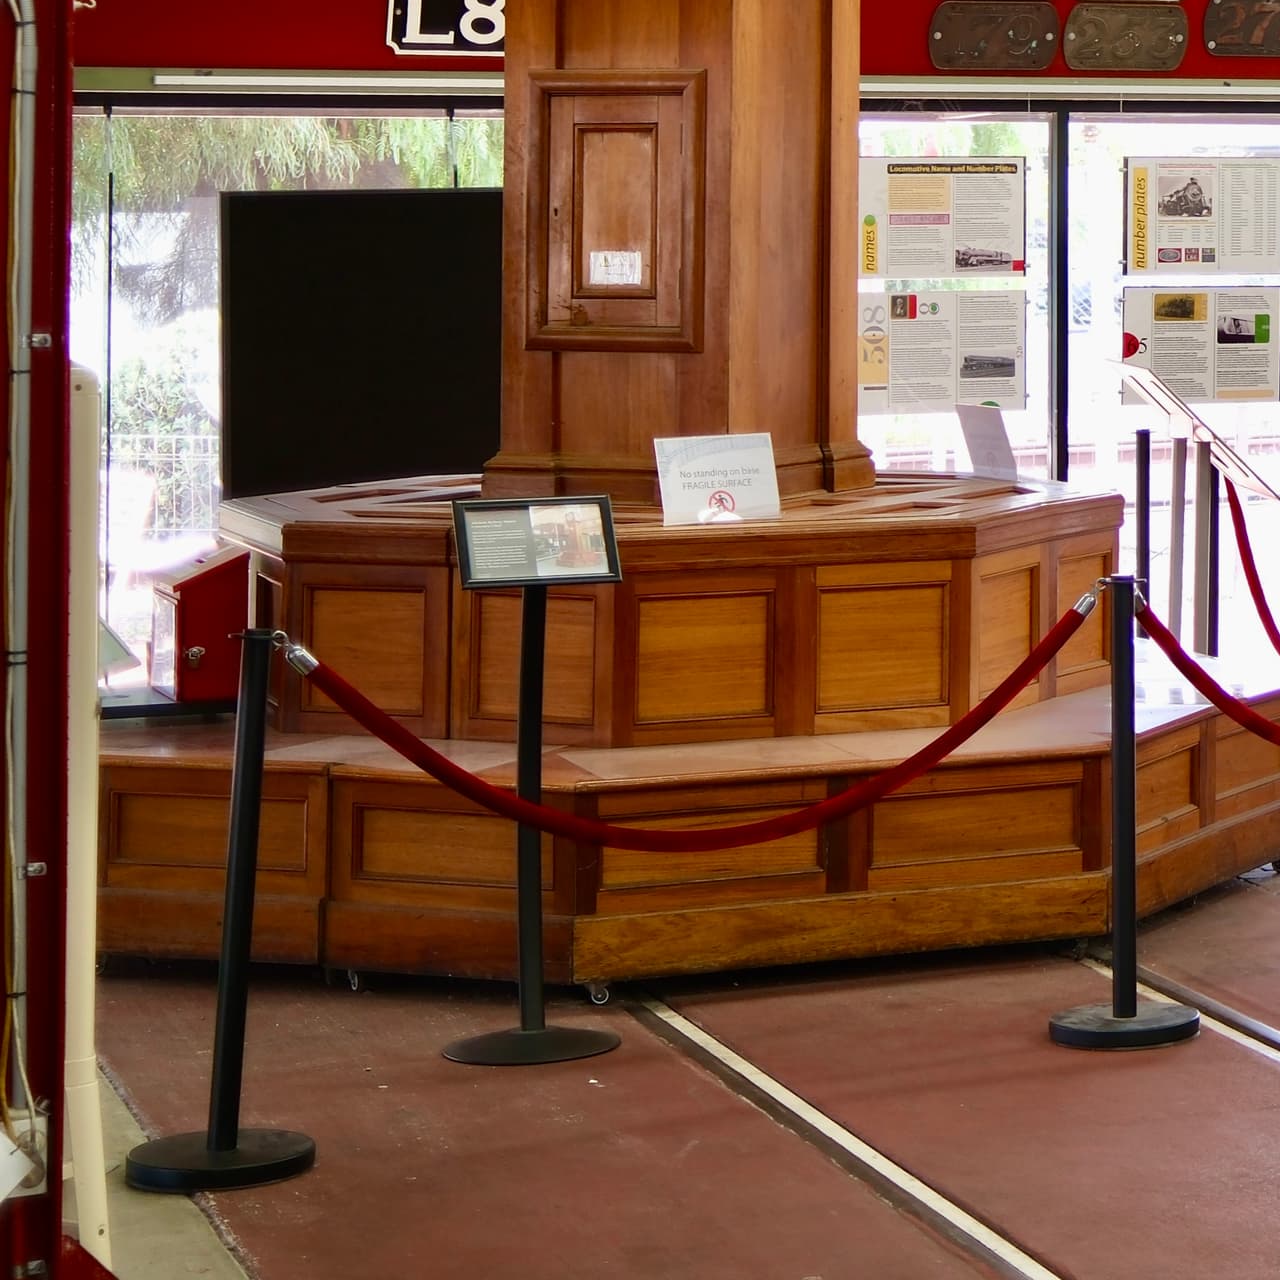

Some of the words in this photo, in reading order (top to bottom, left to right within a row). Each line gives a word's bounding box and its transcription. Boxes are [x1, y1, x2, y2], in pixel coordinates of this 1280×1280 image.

[1133, 176, 1148, 218] plates
[865, 229, 876, 271] names
[1133, 219, 1146, 269] number
[862, 306, 886, 365] 508
[680, 470, 692, 479] No
[693, 468, 728, 479] standing
[682, 480, 716, 491] FRAGILE
[717, 478, 753, 489] SURFACE
